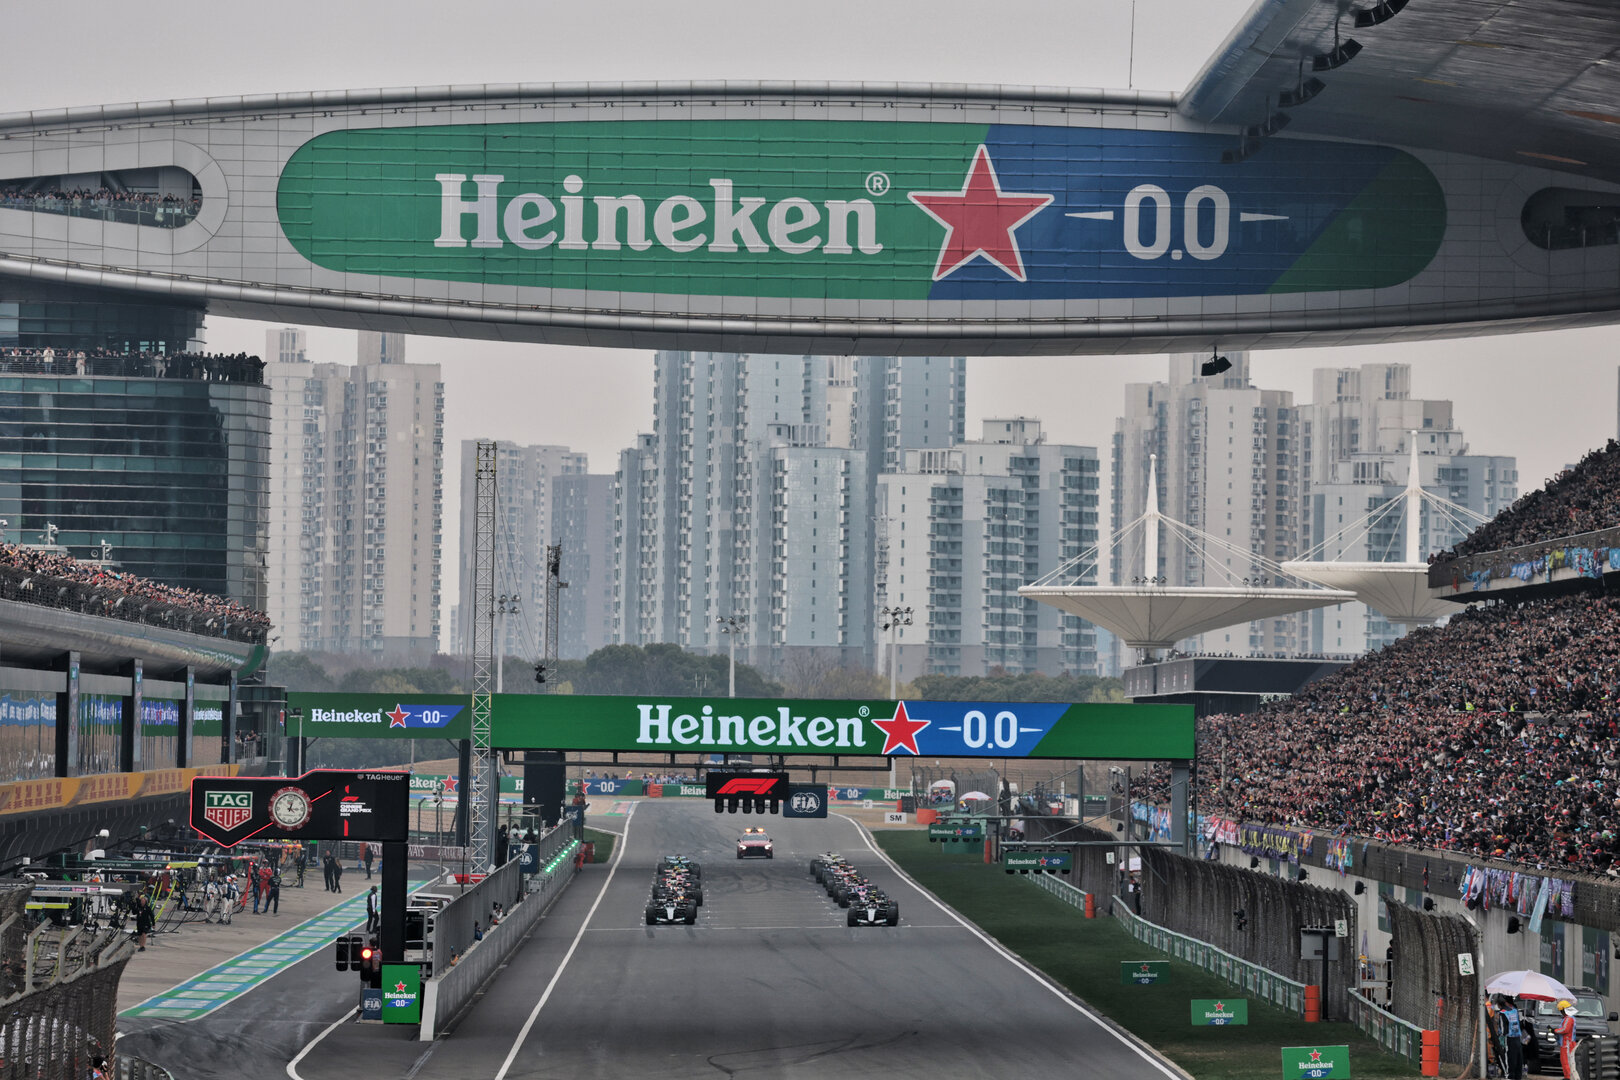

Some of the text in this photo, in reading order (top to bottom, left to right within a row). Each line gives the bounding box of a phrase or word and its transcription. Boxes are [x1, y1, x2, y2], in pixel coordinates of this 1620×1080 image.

[209, 794, 248, 806] TAG
[207, 808, 250, 828] HEUER
[889, 814, 902, 822] SM
